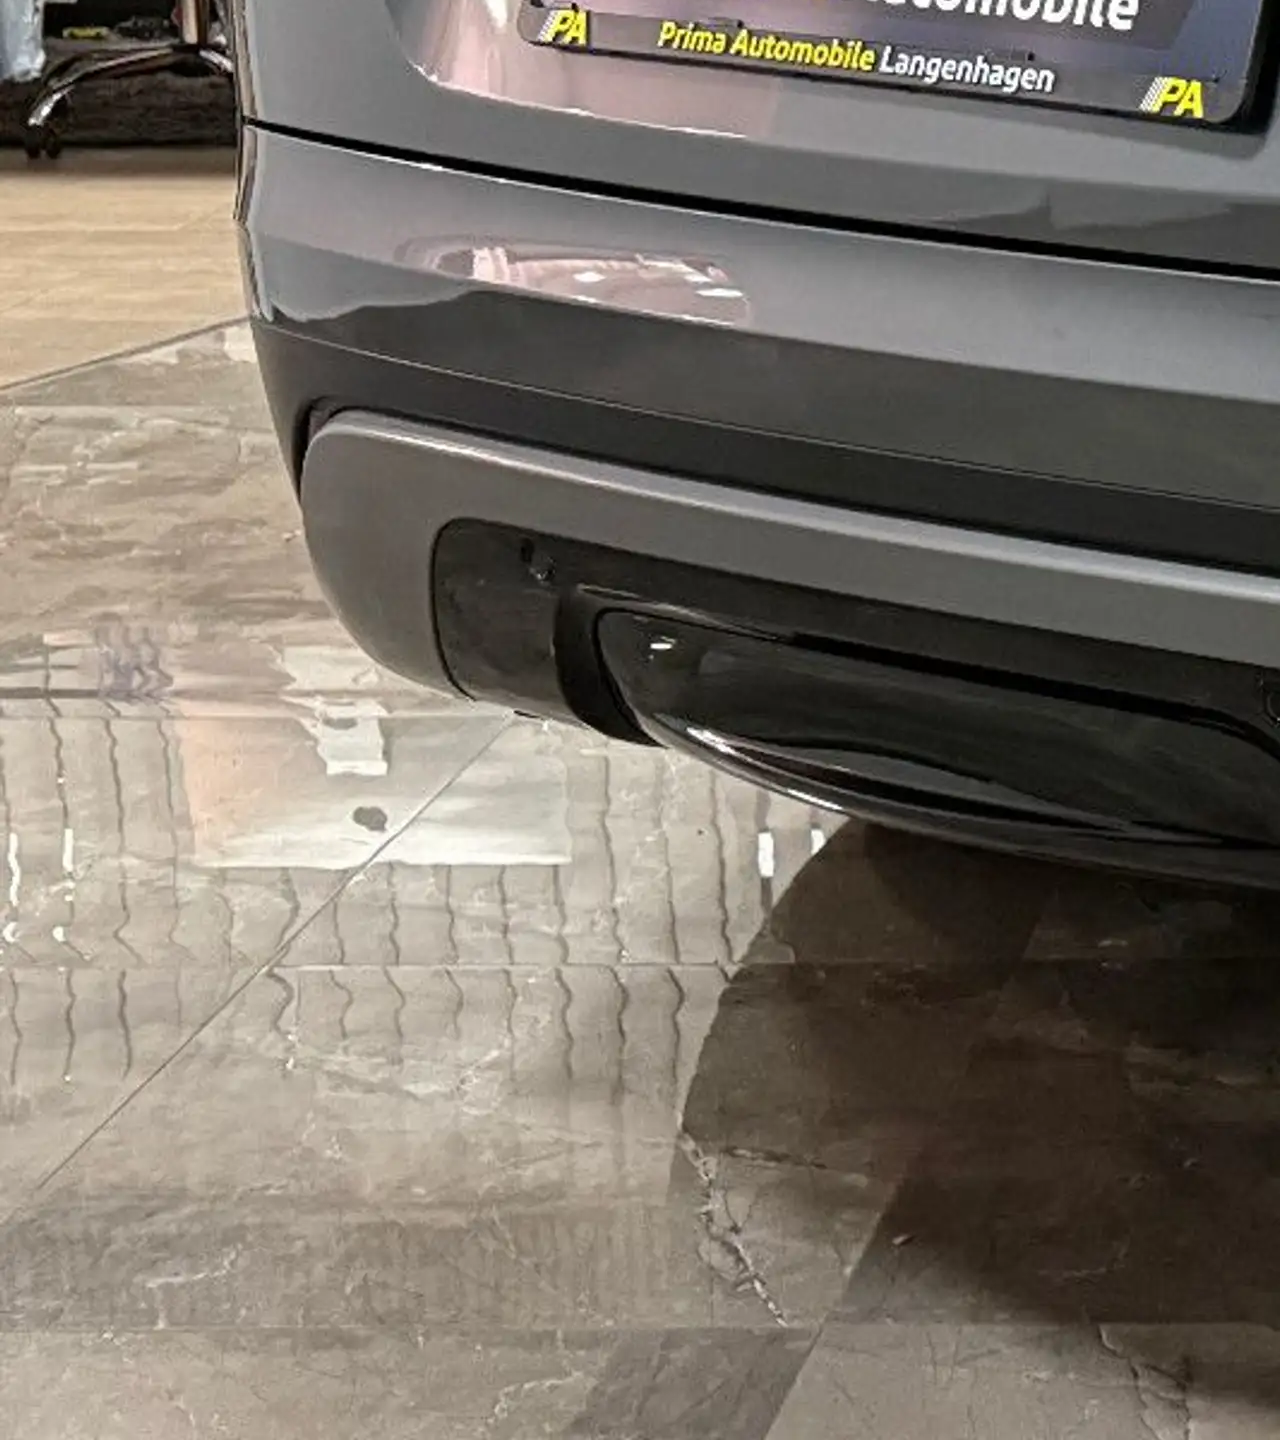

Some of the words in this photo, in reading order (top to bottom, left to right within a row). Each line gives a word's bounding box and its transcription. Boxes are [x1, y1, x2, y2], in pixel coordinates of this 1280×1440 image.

[546, 8, 588, 46] PA
[656, 20, 726, 54] Prima
[730, 28, 876, 72] Automobile
[878, 44, 1056, 94] Langenhagen
[1152, 76, 1204, 119] PA
